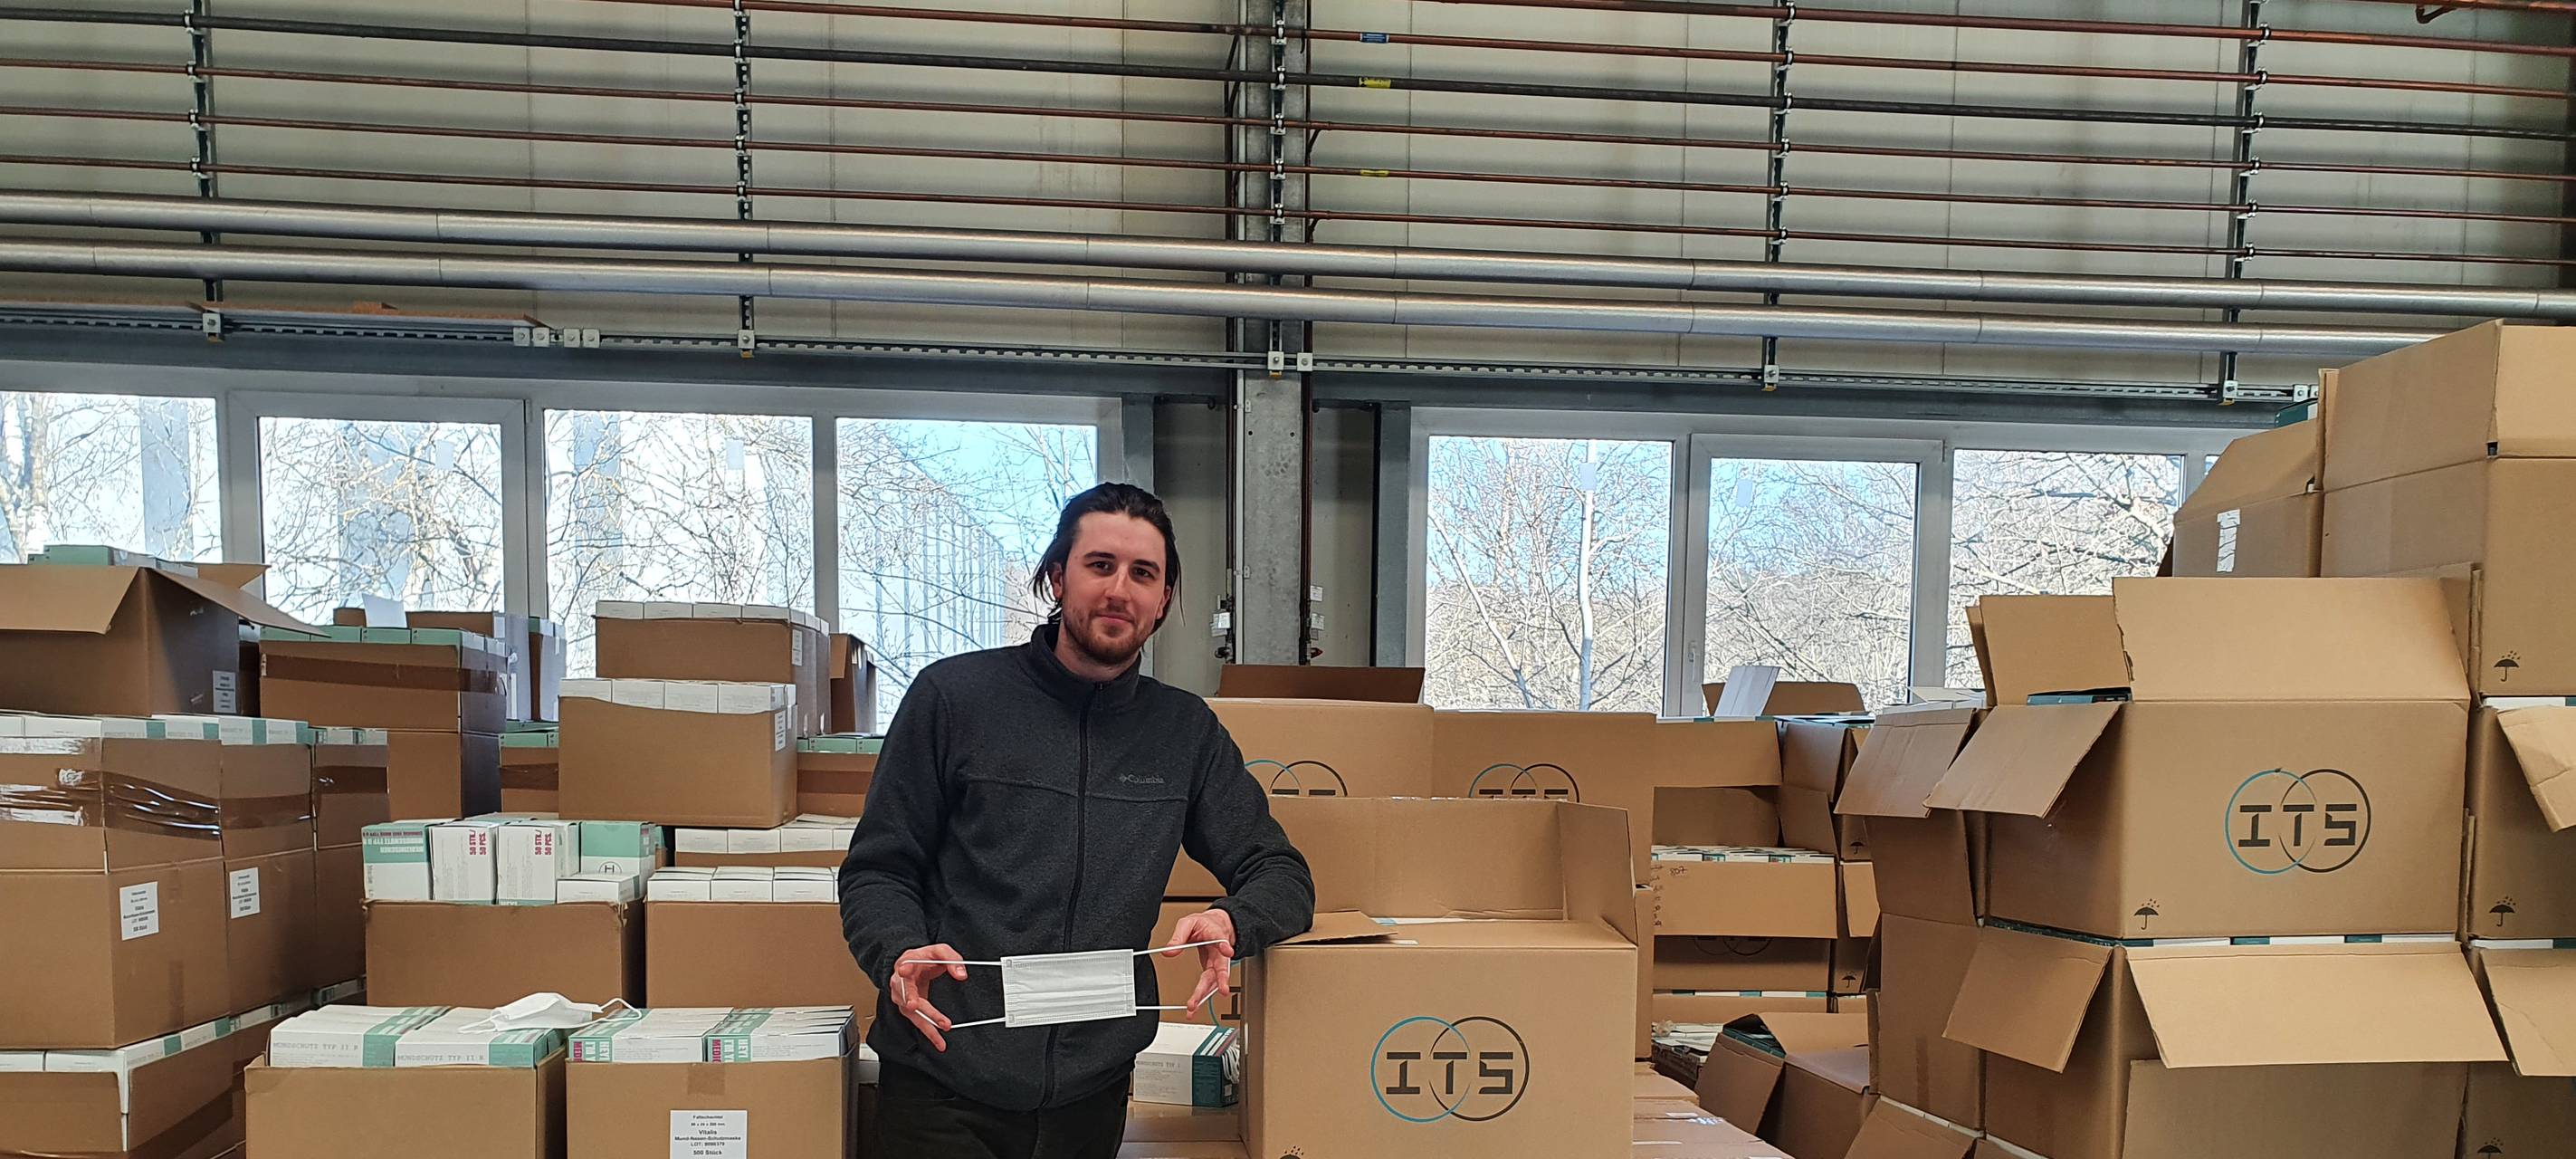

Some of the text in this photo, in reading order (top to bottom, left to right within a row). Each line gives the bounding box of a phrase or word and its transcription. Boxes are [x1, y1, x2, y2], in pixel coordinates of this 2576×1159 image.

[1129, 773, 1165, 784] Columbia
[2237, 803, 2358, 848] ITS
[469, 847, 477, 856] 50
[479, 847, 487, 856] 50
[534, 847, 542, 856] 50
[544, 847, 552, 856] 50
[1386, 1051, 1513, 1094] ITS
